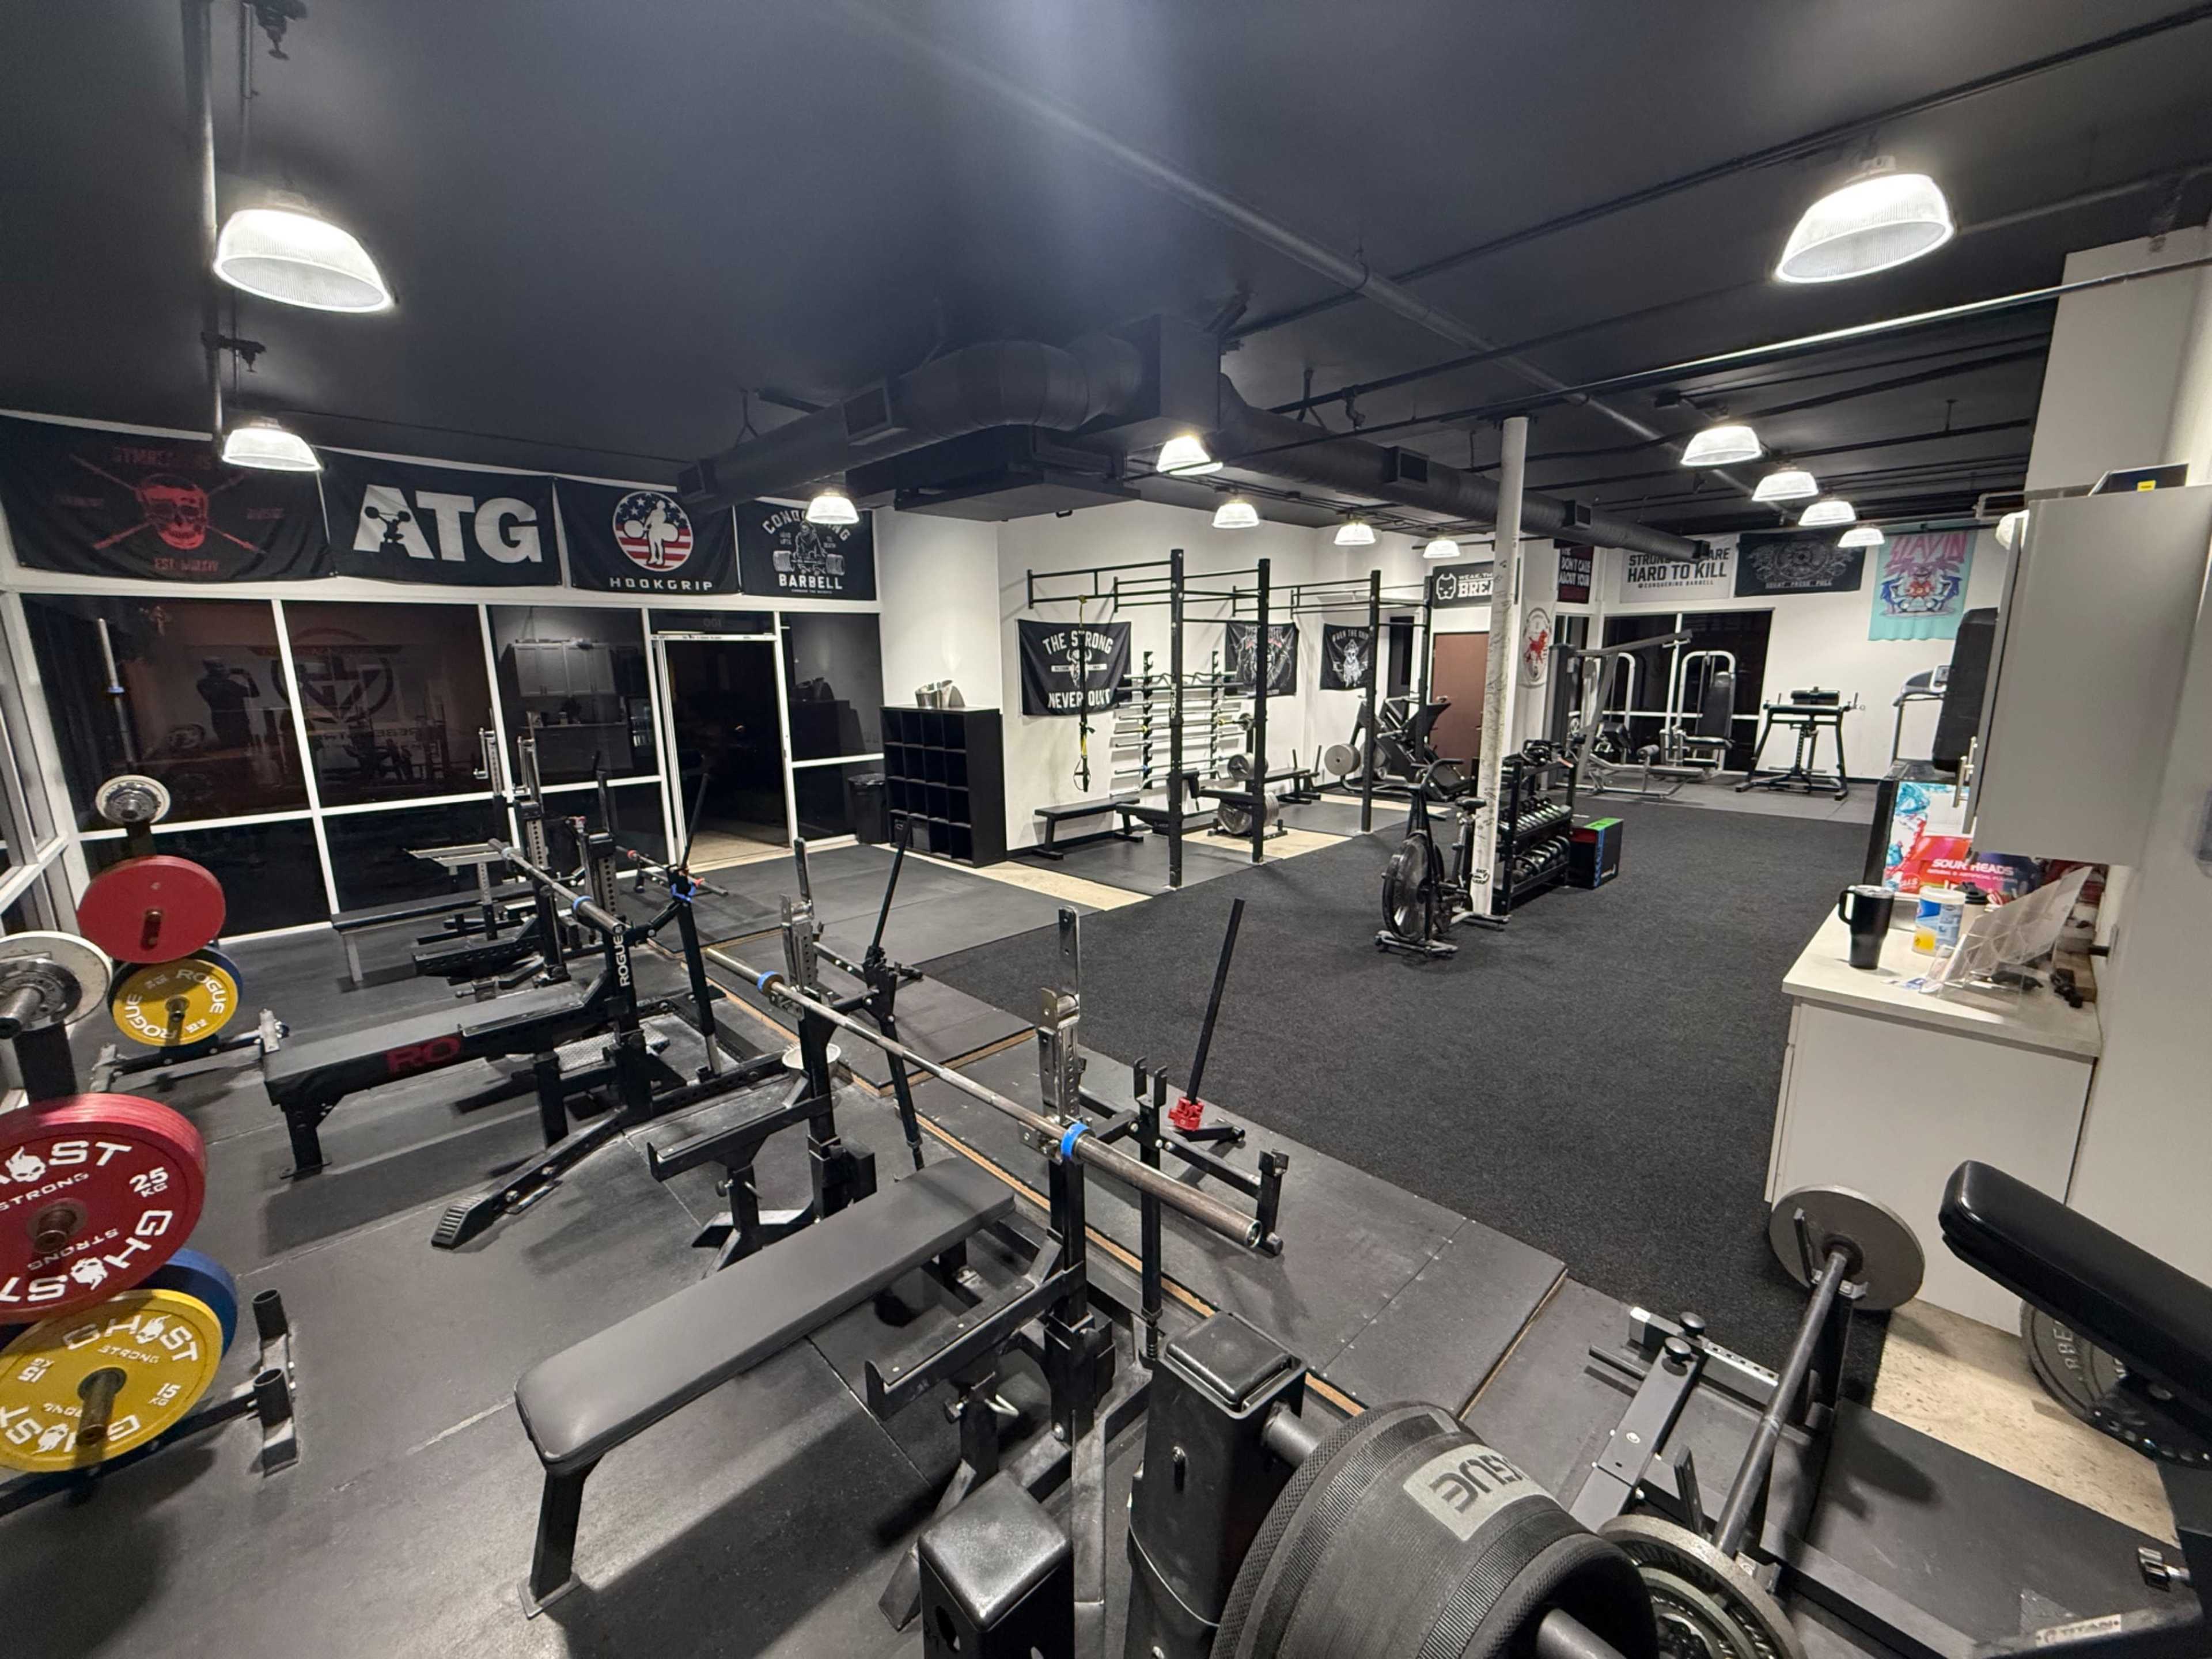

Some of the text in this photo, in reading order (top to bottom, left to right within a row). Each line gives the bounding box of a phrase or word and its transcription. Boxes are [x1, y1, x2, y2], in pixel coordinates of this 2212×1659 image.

[353, 484, 542, 563] ATG
[762, 510, 851, 541] CONQNG
[778, 574, 843, 590] BARBELL
[1627, 562, 1727, 583] HARD TO KILL
[609, 577, 714, 591] HOOKGRIP
[1042, 630, 1113, 655] THE SRONG
[1047, 688, 1111, 709] NEVER QUIT
[1931, 858, 2014, 876] SOUR HEADS
[613, 935, 631, 987] ROGUE
[176, 969, 226, 1014] ROGUE
[124, 994, 177, 1039] ROGUE
[129, 1166, 168, 1192] 25
[0, 1172, 89, 1211] STRONG
[140, 1182, 169, 1198] KG
[28, 1228, 119, 1271] STRONG
[31, 1357, 55, 1369] KG
[97, 1344, 161, 1364] STRONG
[18, 1366, 47, 1382] 15
[147, 1396, 170, 1407] KG
[156, 1382, 181, 1400] 15
[43, 1403, 82, 1418] RONG
[1429, 1455, 1524, 1514] GUE
